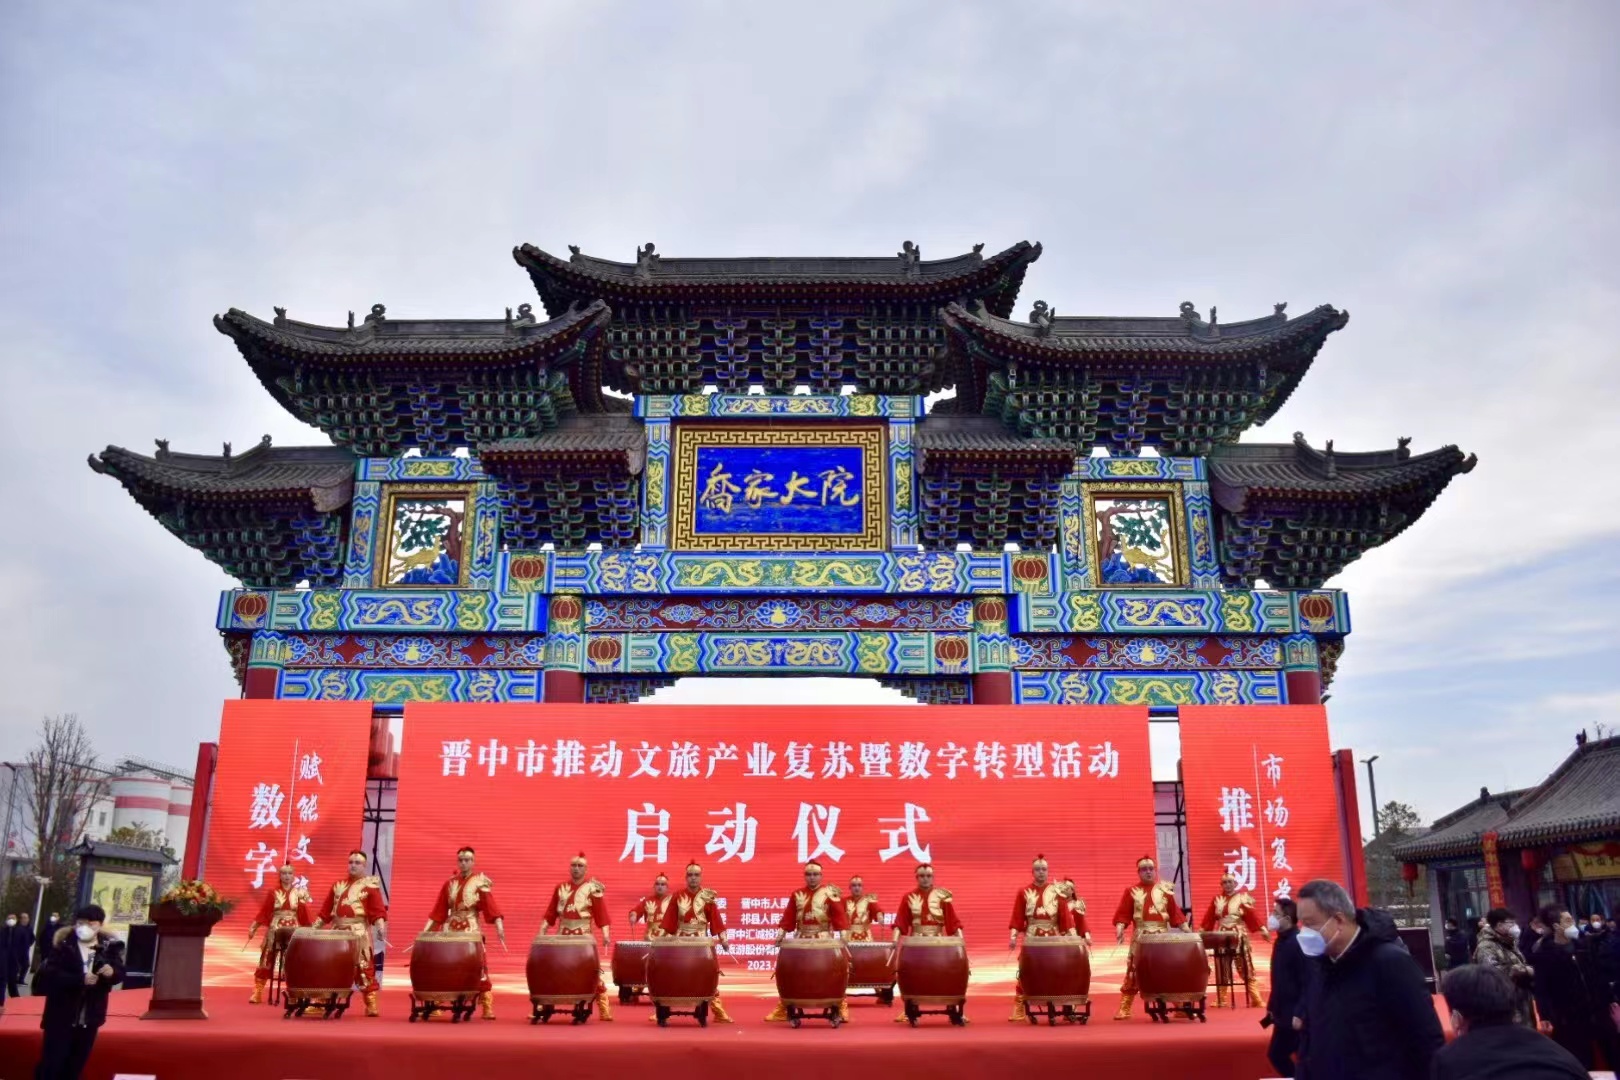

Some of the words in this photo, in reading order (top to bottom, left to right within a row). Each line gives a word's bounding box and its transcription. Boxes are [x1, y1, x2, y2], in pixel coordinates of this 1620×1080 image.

[438, 738, 1120, 780] 晋中市推动文旅产业复苏暨数字转型活动
[243, 782, 286, 889] 数字
[618, 801, 932, 864] 启动仪式
[1217, 786, 1257, 892] 推动
[747, 960, 777, 971] 2023.
